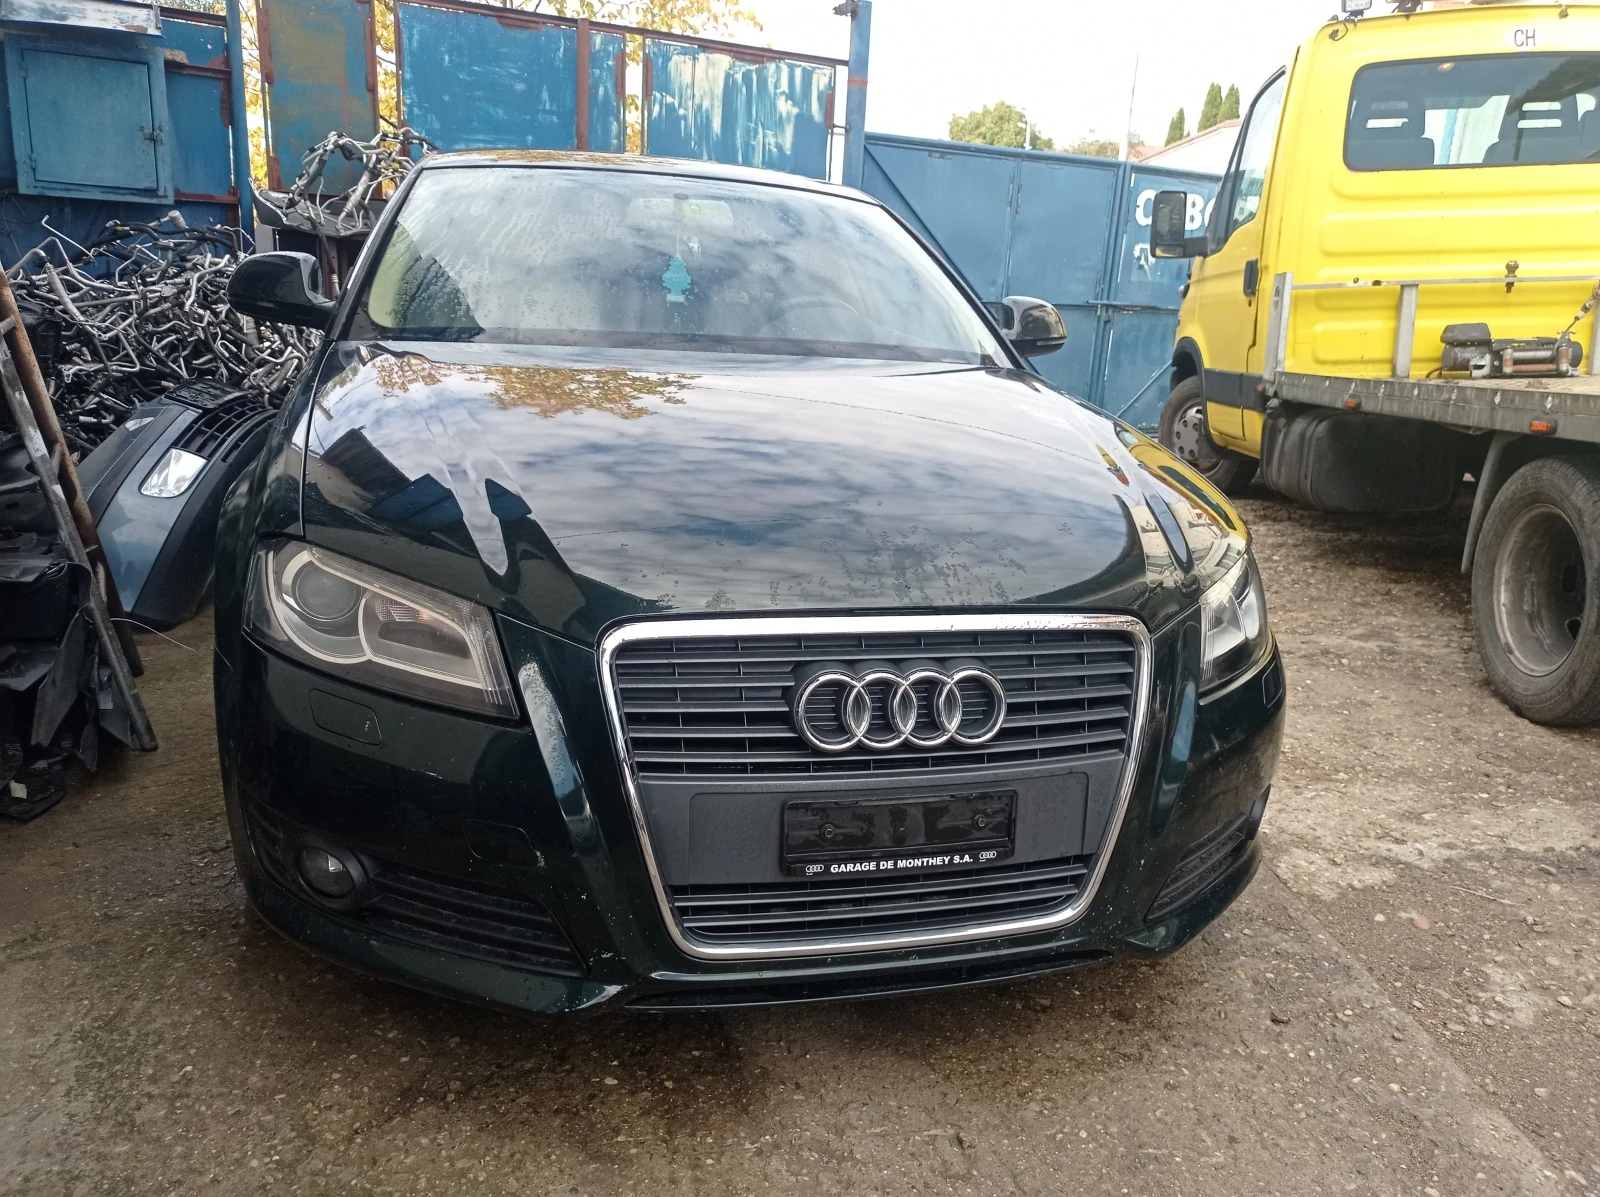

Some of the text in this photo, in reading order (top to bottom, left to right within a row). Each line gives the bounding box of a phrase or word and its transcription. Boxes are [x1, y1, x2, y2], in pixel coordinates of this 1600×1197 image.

[1514, 28, 1536, 47] CH
[830, 854, 974, 873] GARAGE DE MONTHEY S.A.
